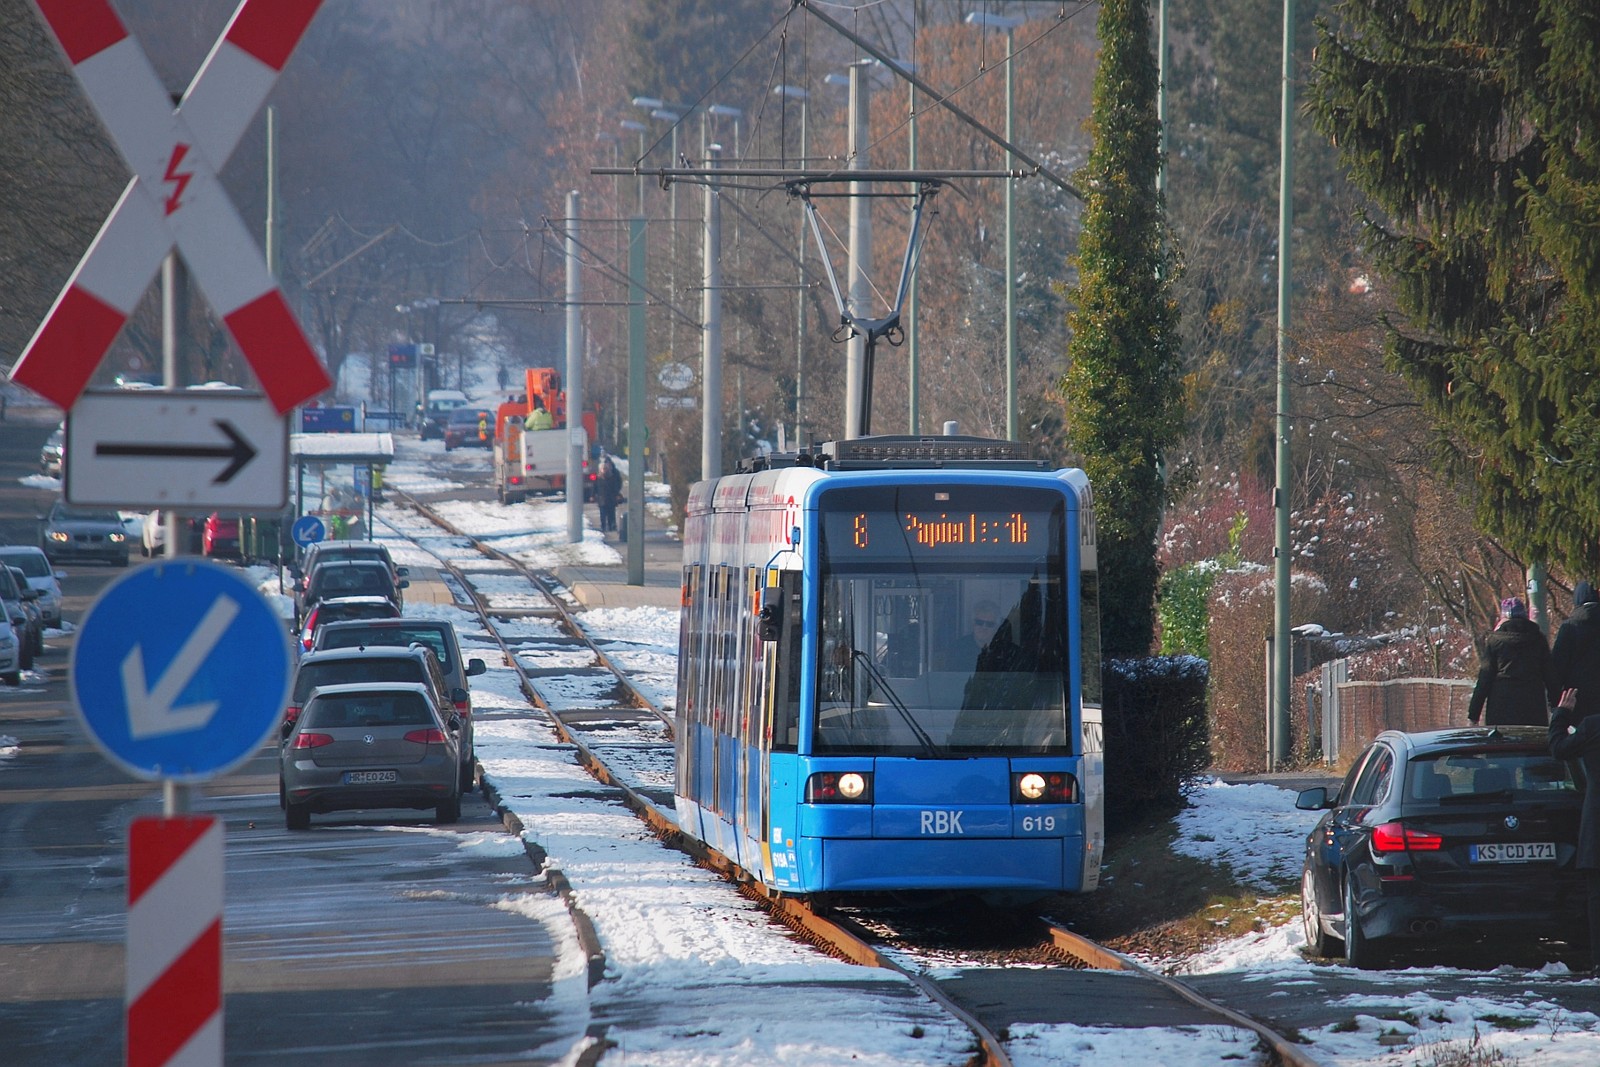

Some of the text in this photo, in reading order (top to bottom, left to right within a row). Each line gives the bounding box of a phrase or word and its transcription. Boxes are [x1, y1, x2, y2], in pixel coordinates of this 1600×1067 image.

[379, 772, 395, 781] 245
[920, 810, 964, 834] RBK
[1022, 816, 1055, 832] 619
[1478, 844, 1554, 859] KS CD 171
